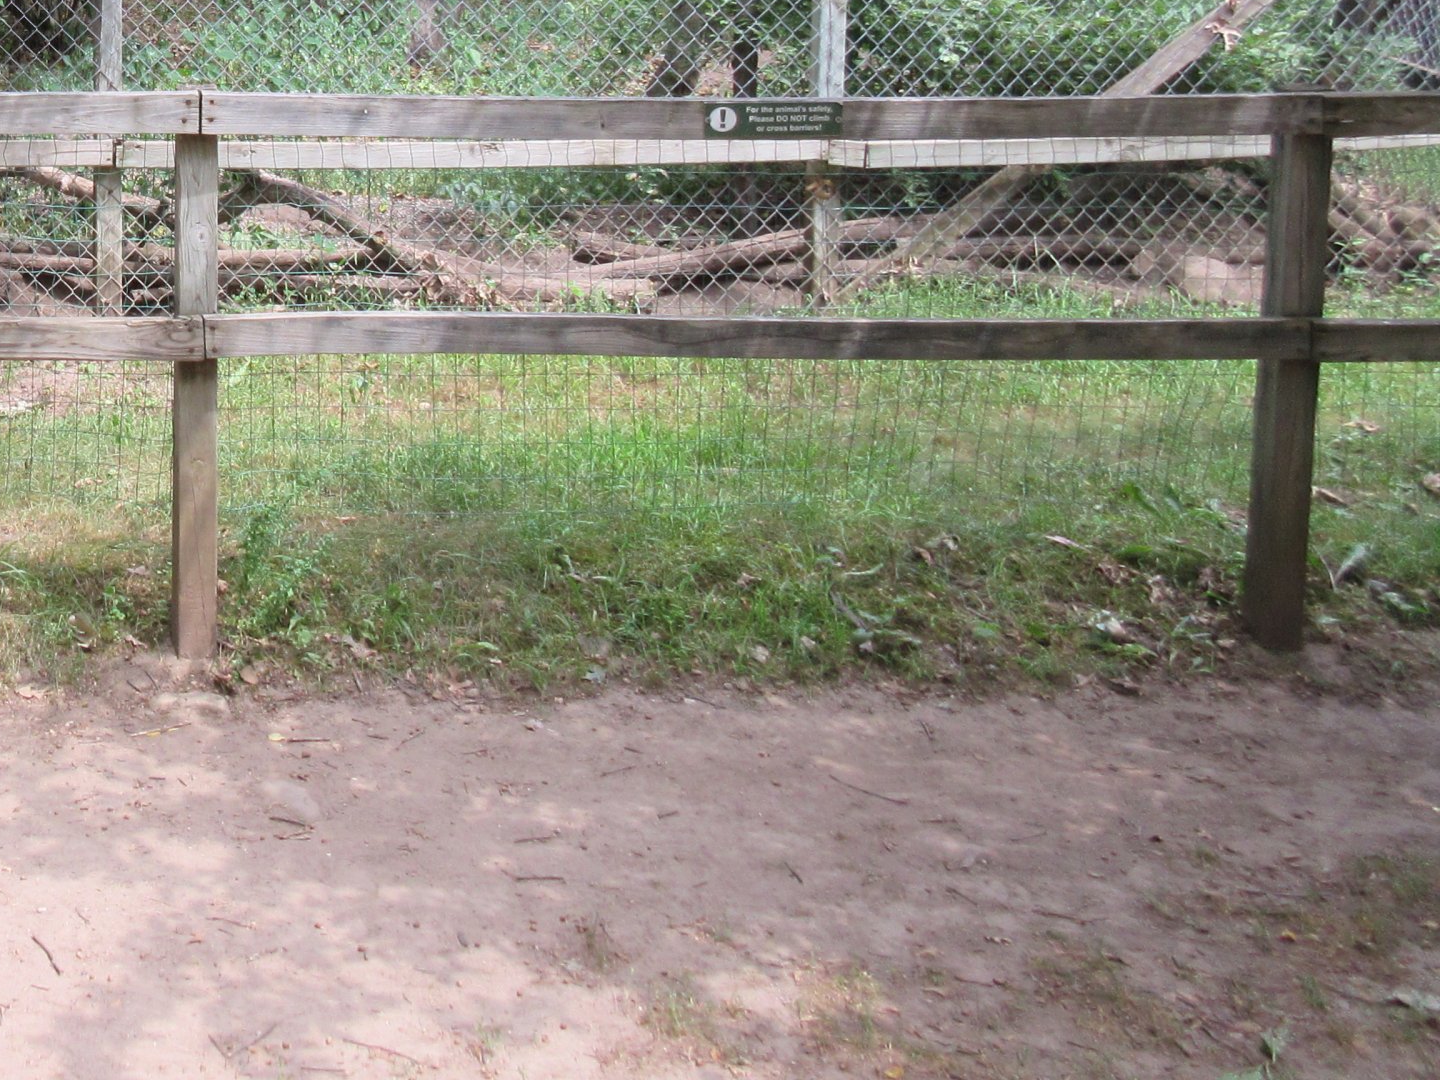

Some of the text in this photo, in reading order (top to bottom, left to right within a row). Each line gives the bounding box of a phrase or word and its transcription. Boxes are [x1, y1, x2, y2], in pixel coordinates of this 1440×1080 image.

[775, 105, 807, 113] animal's
[790, 114, 807, 122] NOT
[809, 114, 830, 122] climb
[789, 123, 822, 131] barriers!
